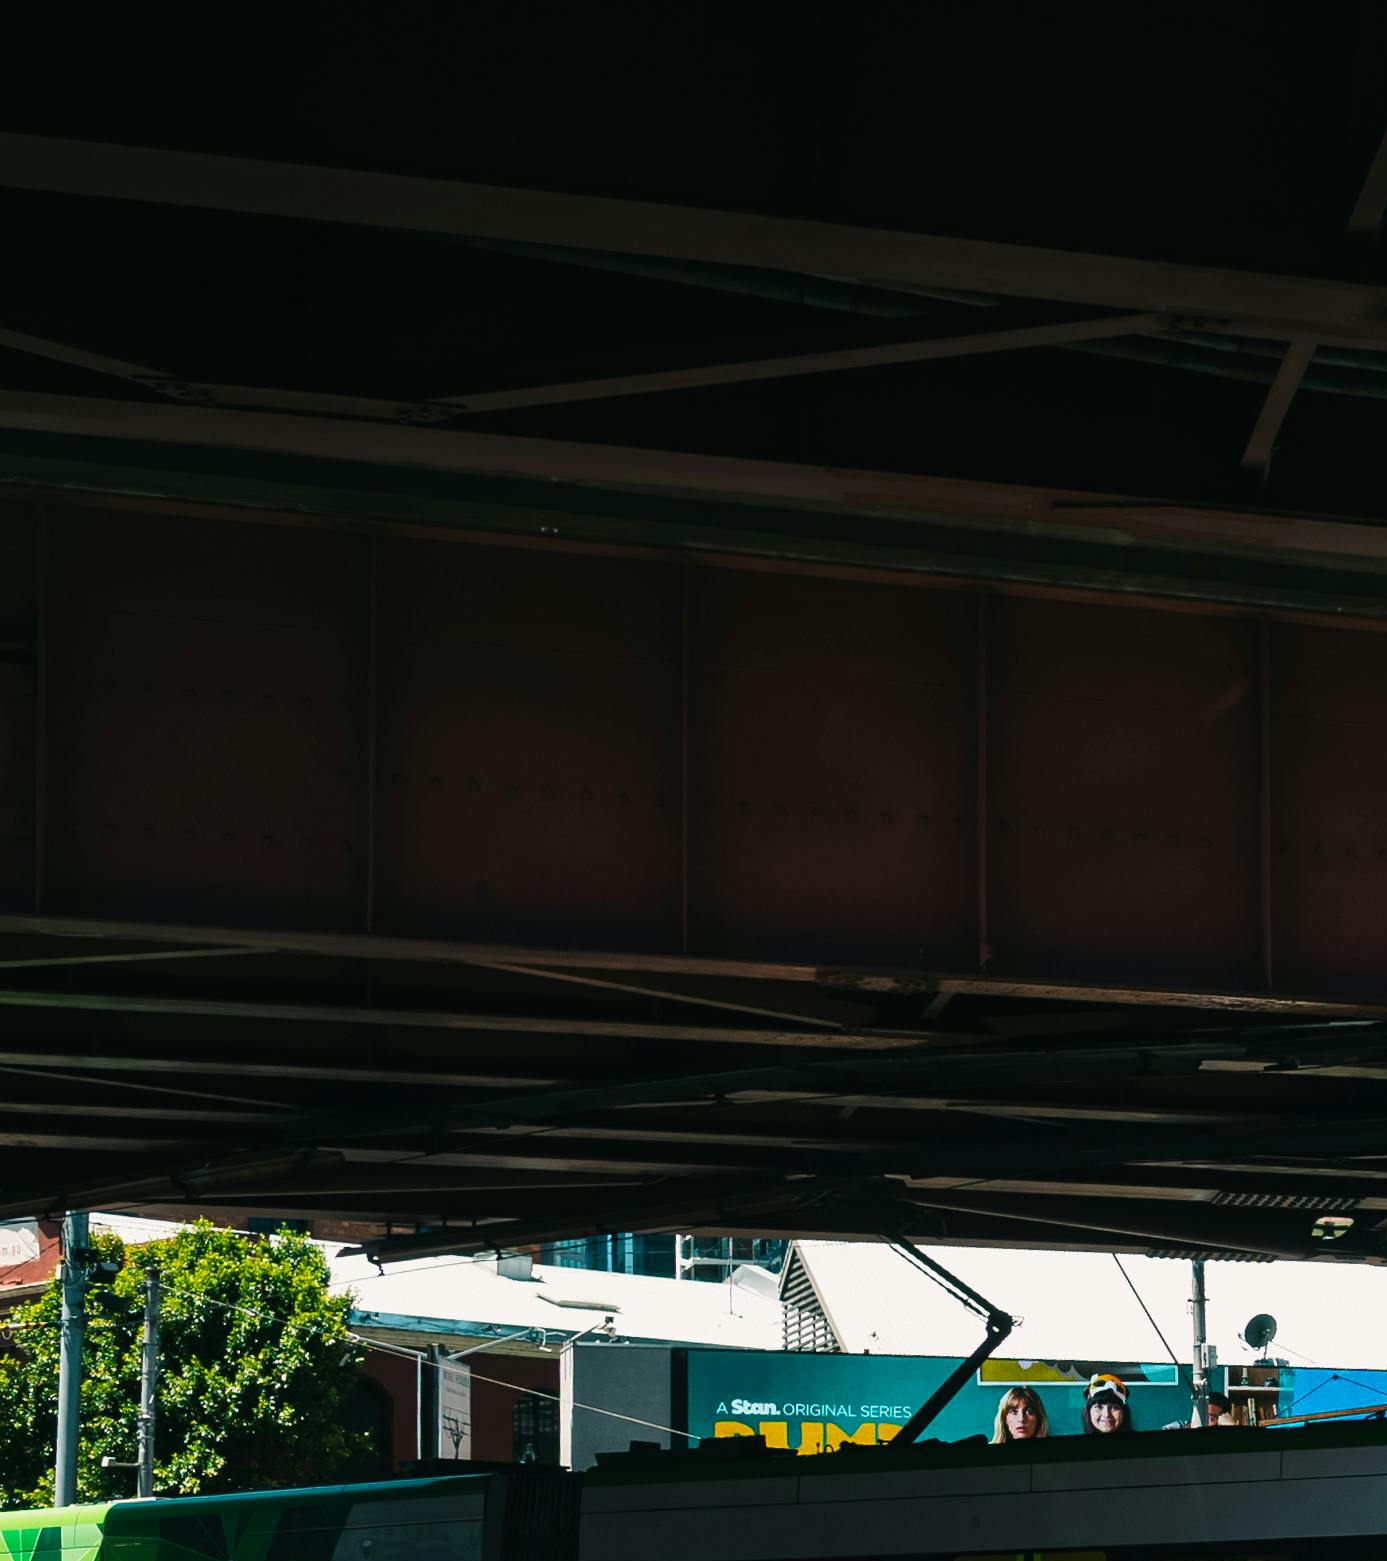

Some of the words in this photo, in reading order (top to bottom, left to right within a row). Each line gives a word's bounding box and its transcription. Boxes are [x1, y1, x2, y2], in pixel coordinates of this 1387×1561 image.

[716, 1402, 728, 1415] A
[731, 1399, 780, 1416] Stan.
[783, 1403, 856, 1417] ORIGINAL
[860, 1405, 912, 1419] SERIES
